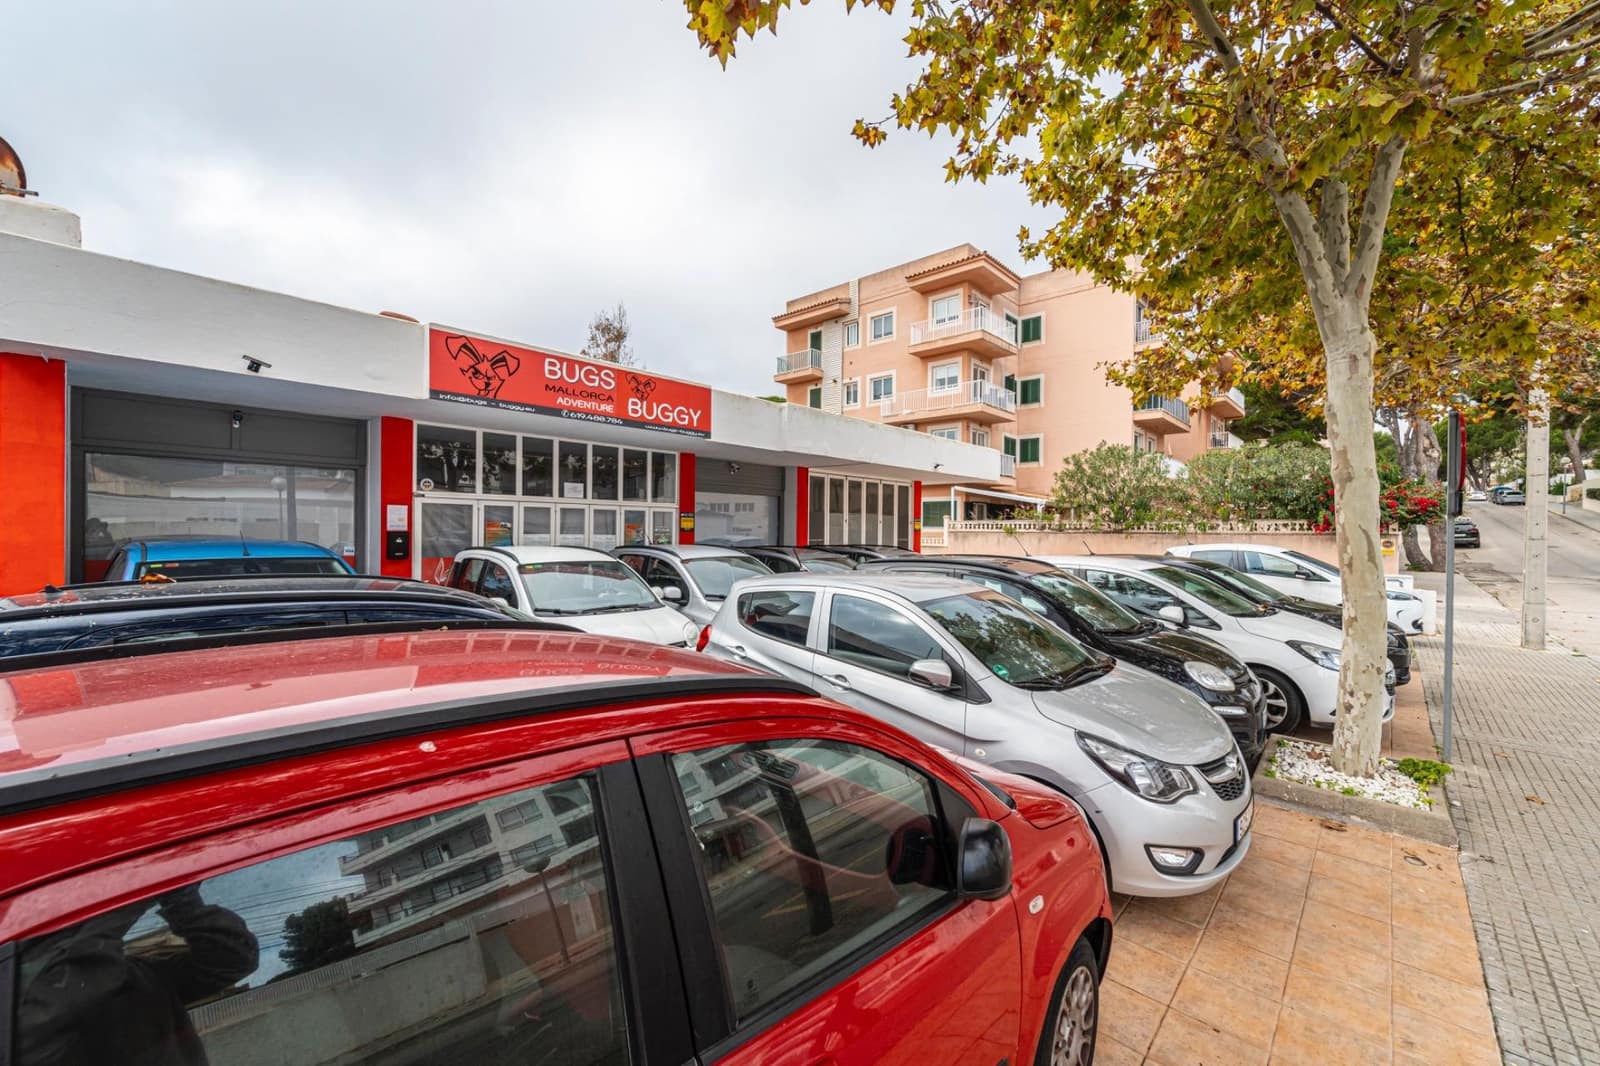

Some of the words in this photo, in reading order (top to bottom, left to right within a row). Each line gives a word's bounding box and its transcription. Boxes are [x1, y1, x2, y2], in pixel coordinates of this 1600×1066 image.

[544, 357, 616, 390] BUGS
[544, 383, 615, 402] MALLORCA
[556, 396, 615, 413] ADVENTURE
[628, 397, 702, 427] BUGGY
